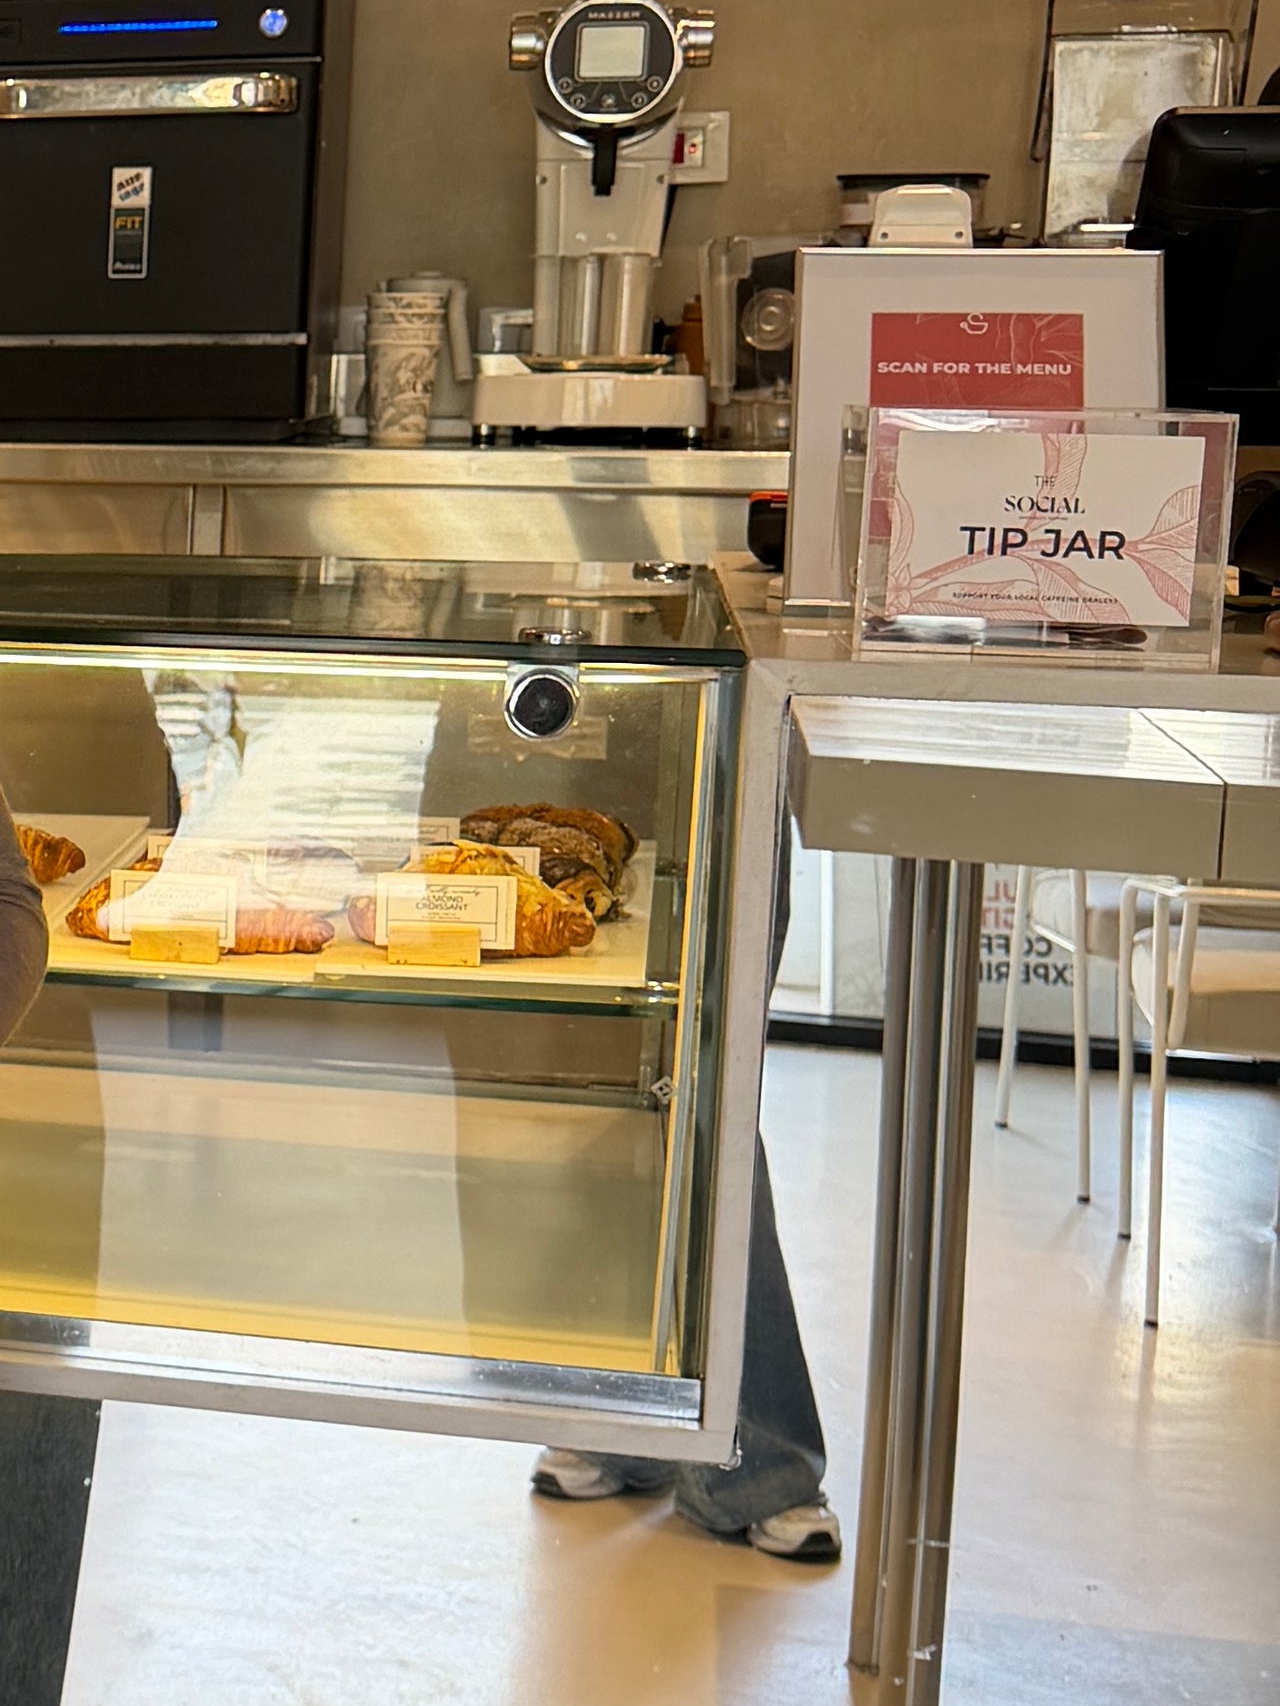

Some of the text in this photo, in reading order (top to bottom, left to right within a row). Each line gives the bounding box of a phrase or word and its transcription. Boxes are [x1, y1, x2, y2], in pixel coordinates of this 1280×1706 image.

[115, 216, 143, 230] FIT
[877, 361, 1072, 375] SCAN FOR THE MENU
[1034, 475, 1056, 487] THE
[1004, 495, 1085, 514] SOCIAL
[960, 526, 1126, 560] TIP JAR
